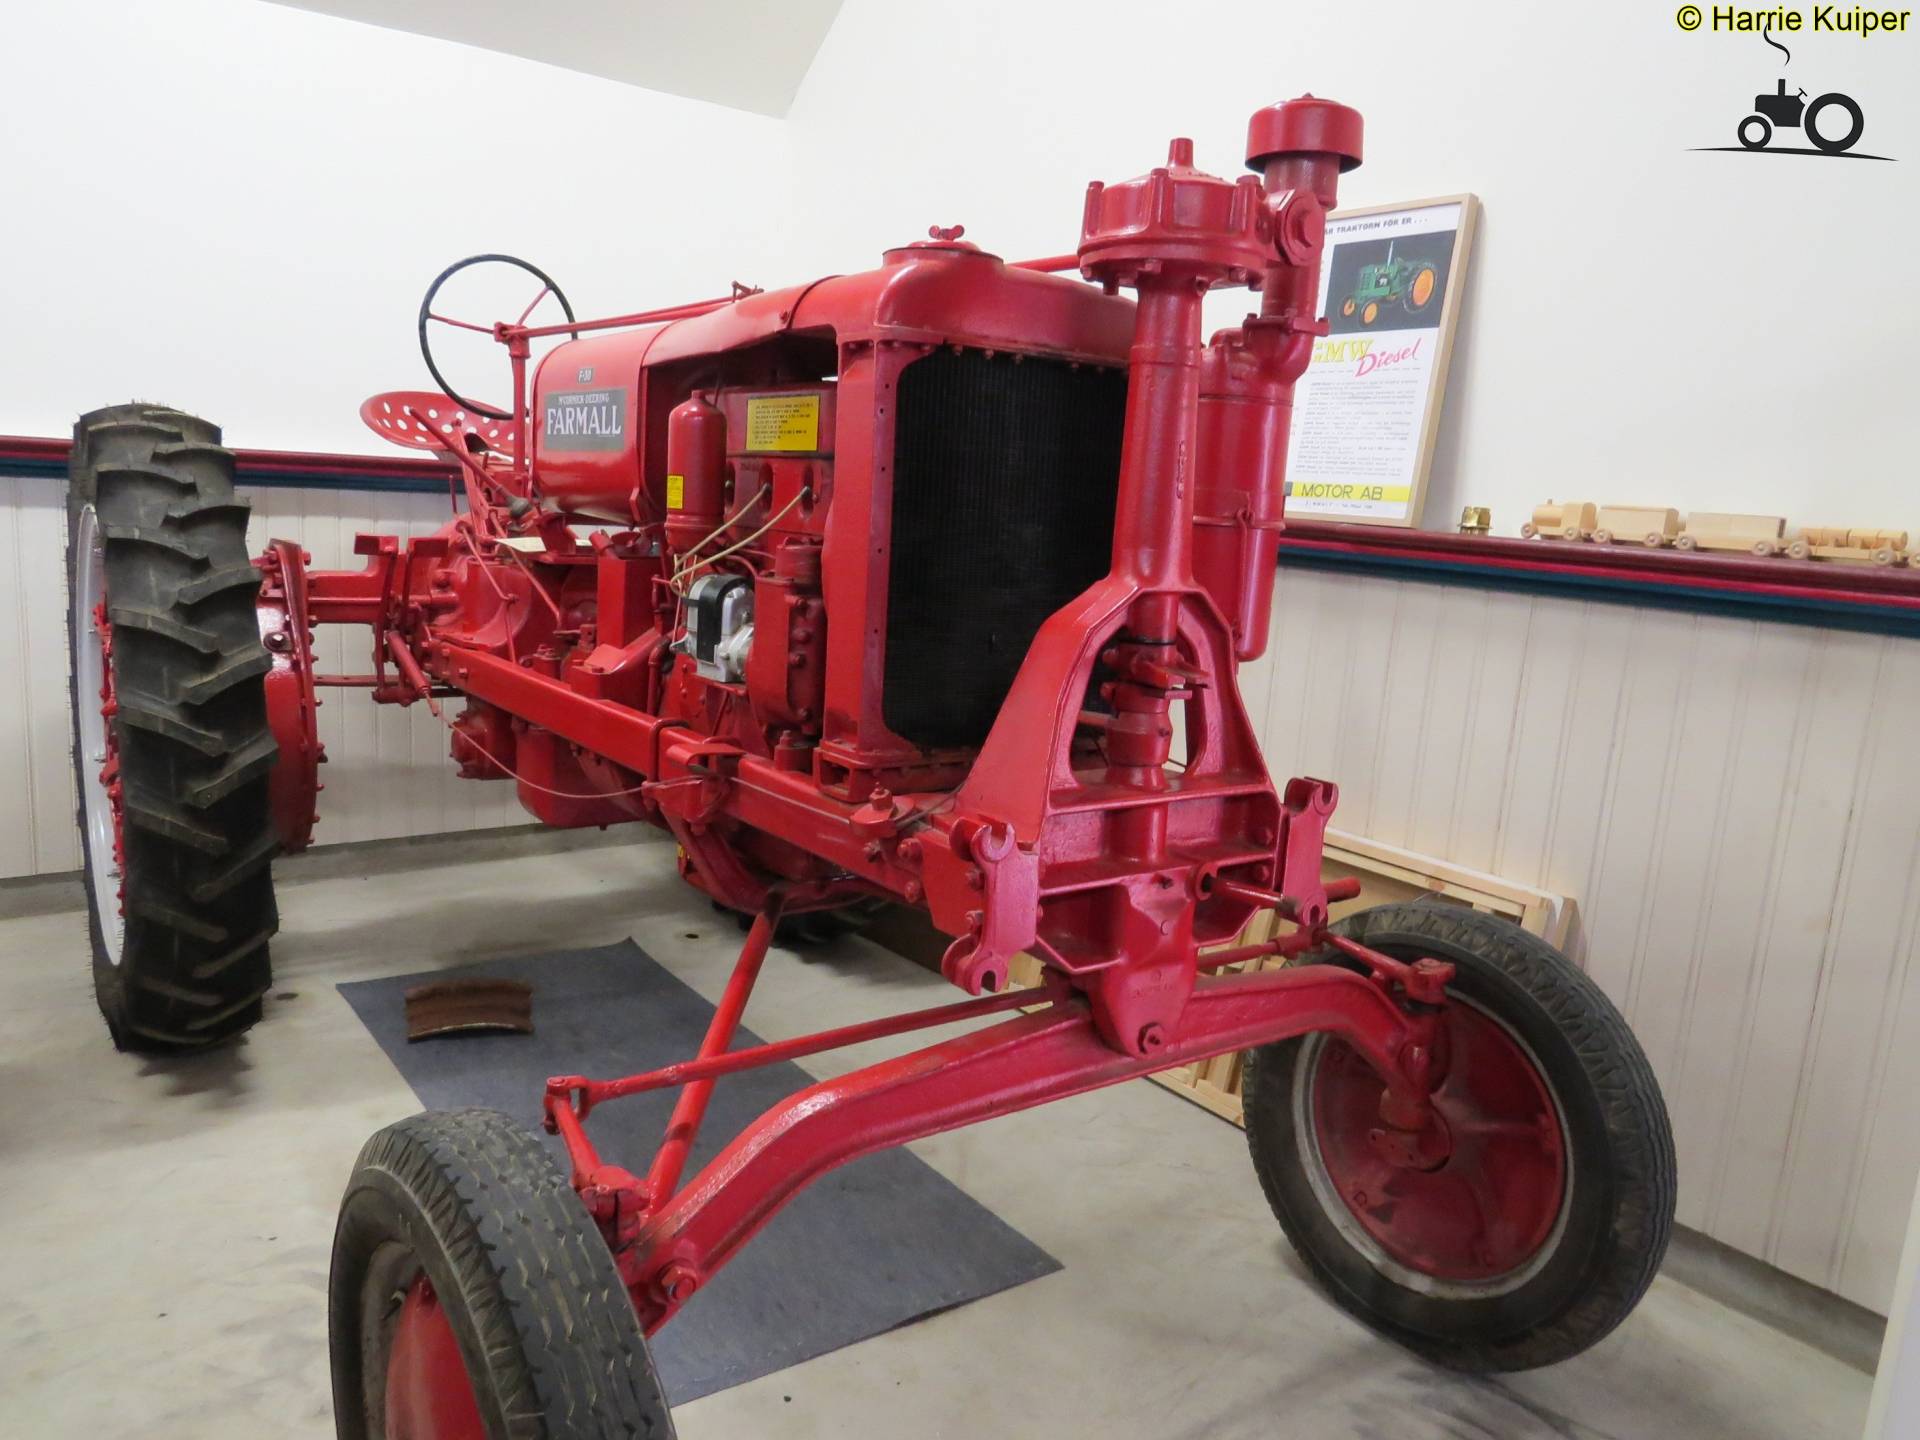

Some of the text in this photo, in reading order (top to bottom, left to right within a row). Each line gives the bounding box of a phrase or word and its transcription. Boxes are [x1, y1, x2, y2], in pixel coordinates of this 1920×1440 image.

[1336, 222, 1380, 234] TRAKTORN
[1355, 337, 1422, 377] Diesel
[547, 405, 622, 435] FARMALL
[1301, 483, 1383, 501] MOTOR AB
